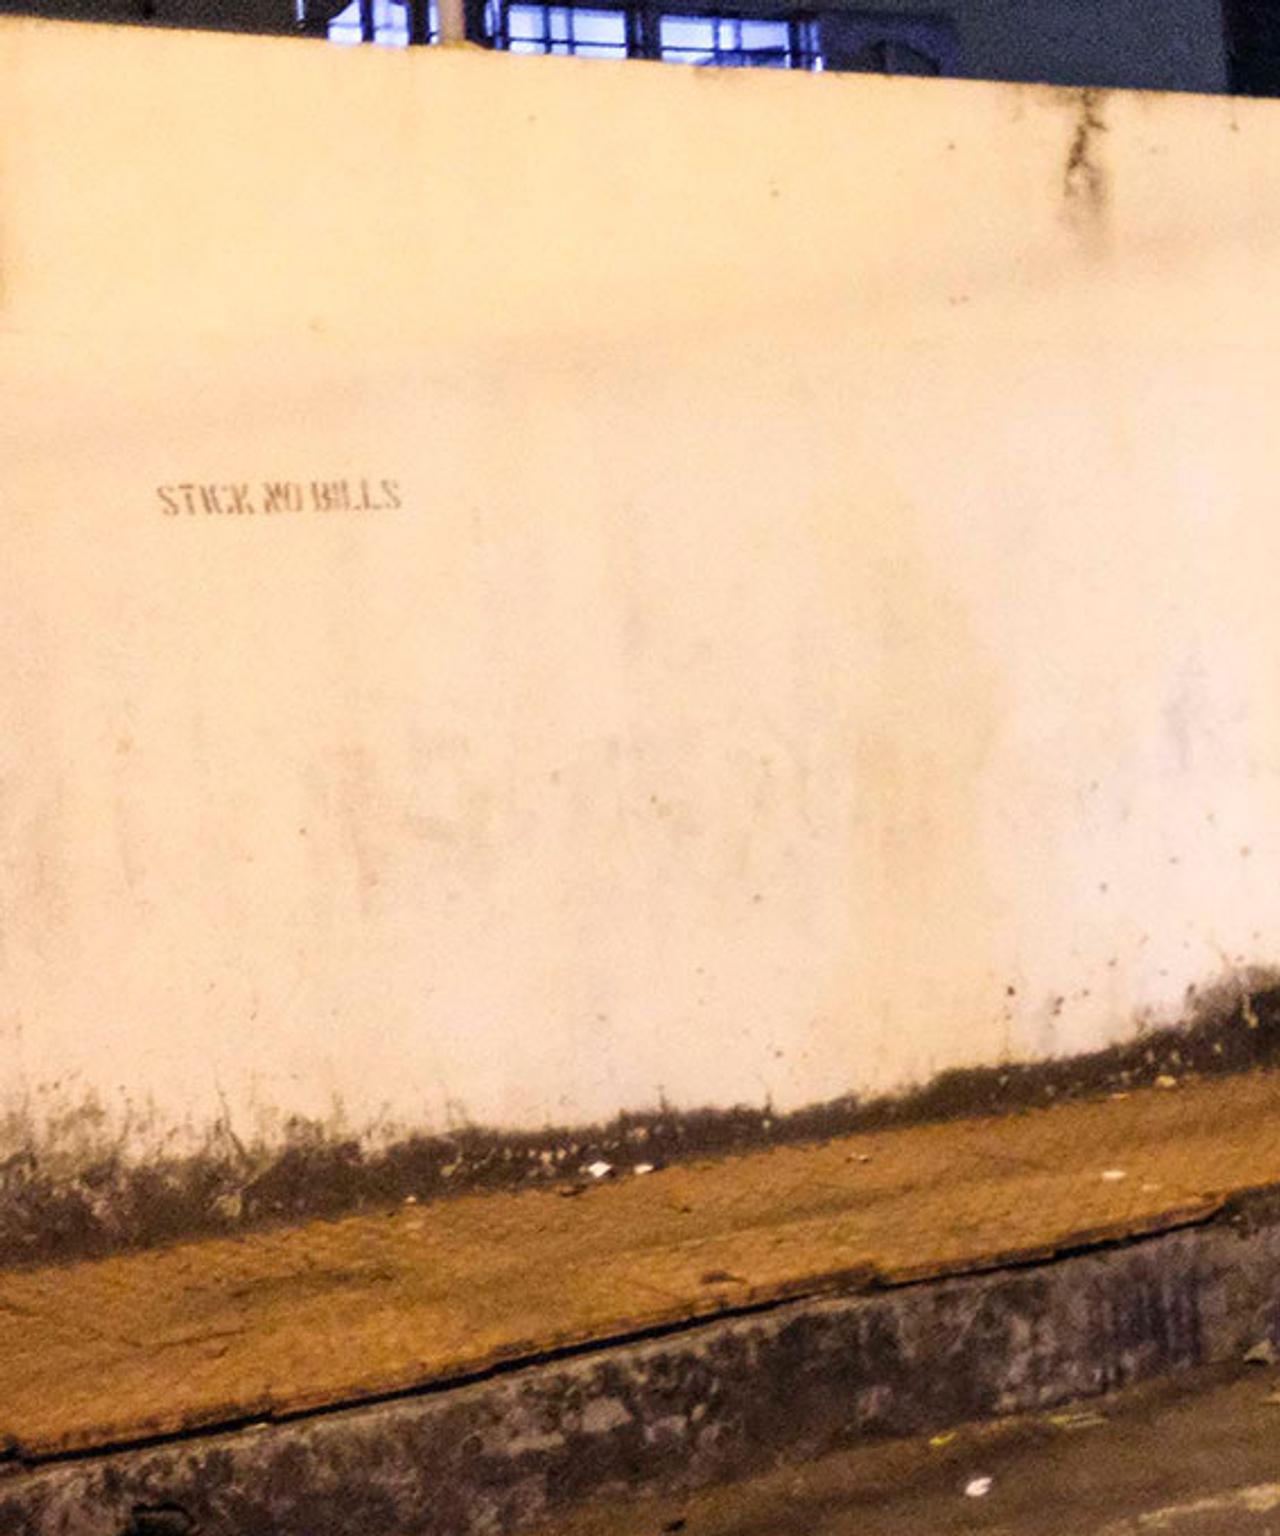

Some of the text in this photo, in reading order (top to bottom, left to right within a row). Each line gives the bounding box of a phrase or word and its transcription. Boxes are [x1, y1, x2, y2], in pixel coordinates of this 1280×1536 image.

[157, 478, 402, 515] STICK NO BILLS
